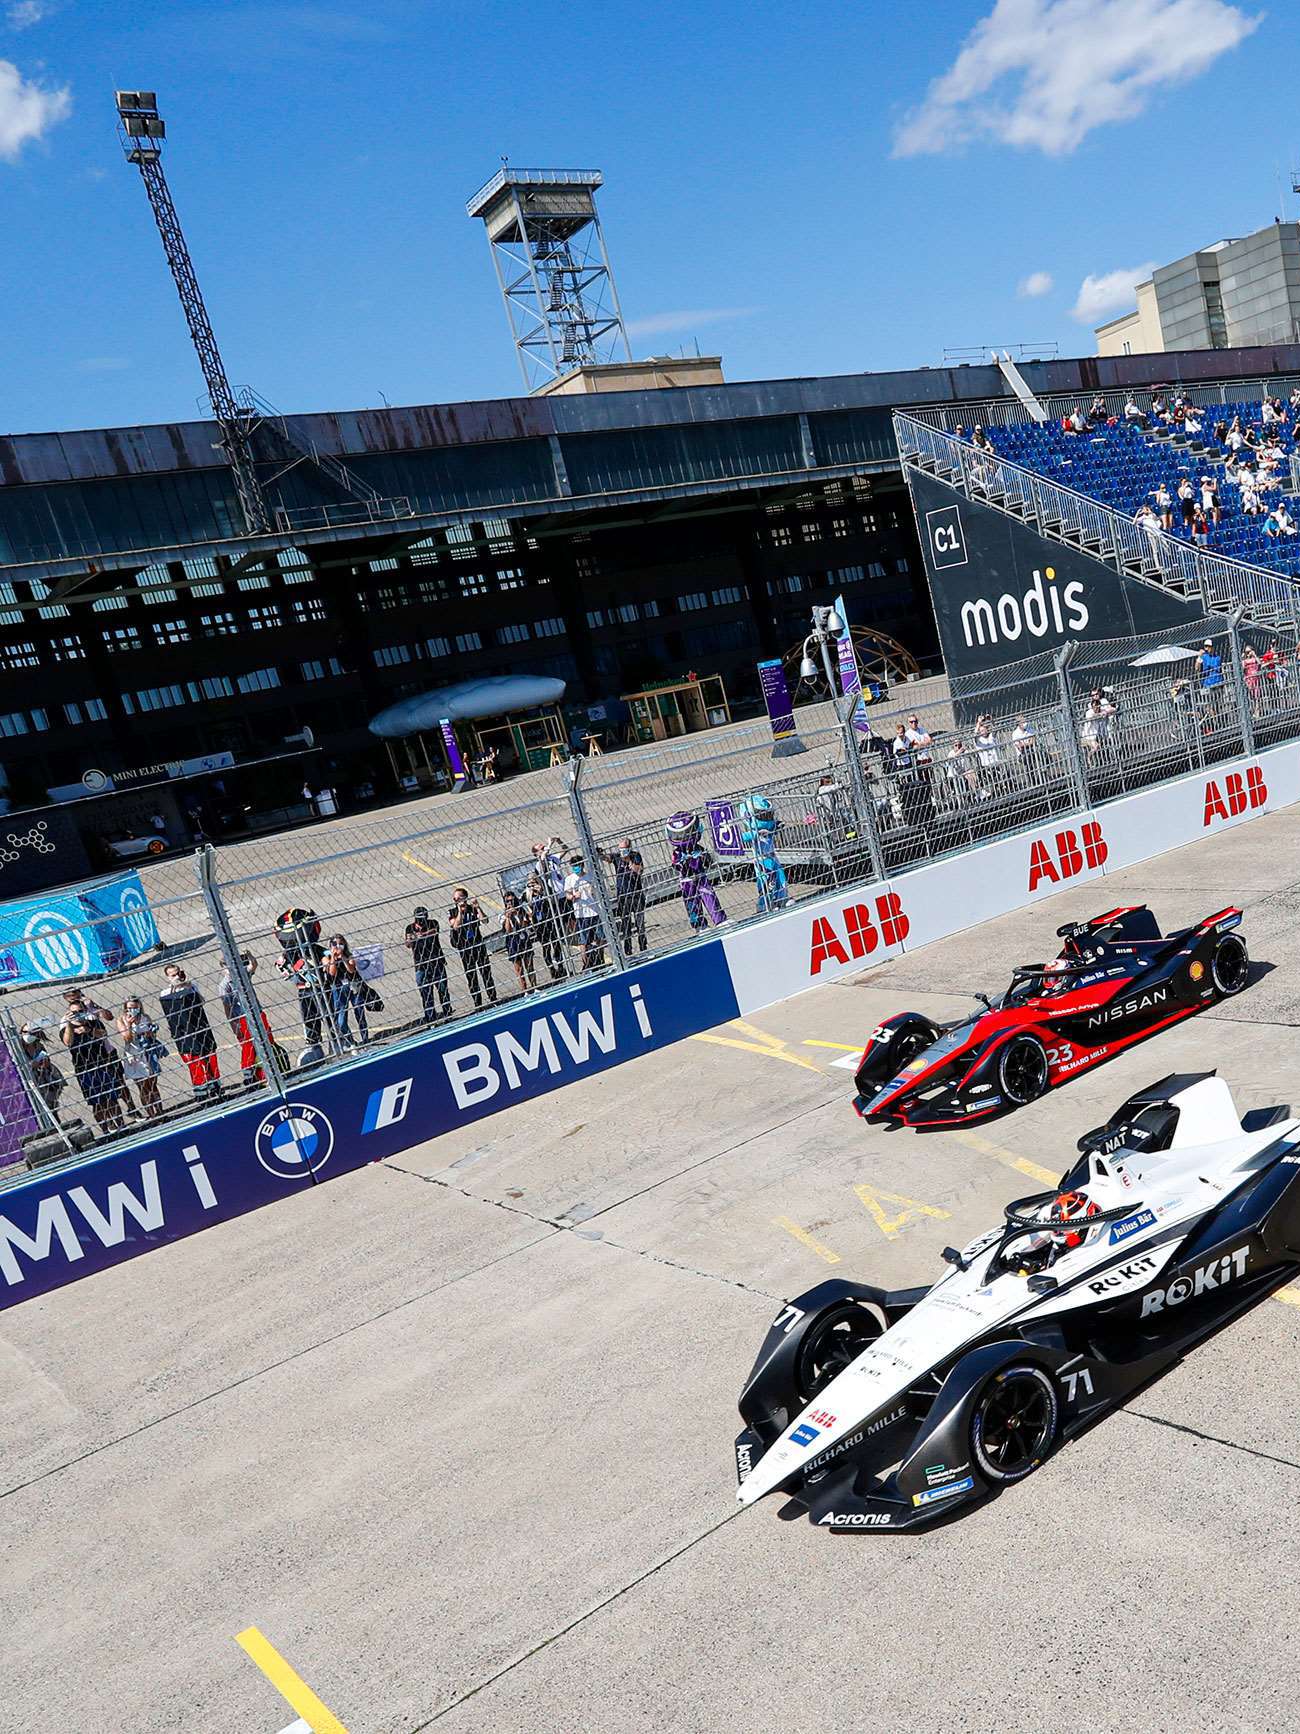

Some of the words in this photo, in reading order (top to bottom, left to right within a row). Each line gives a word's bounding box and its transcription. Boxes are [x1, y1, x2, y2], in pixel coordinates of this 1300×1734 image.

[934, 525, 960, 553] C1
[961, 566, 1089, 647] modis
[112, 769, 138, 782] MINI
[1203, 766, 1267, 827] ABB
[1028, 821, 1108, 892] ABB
[810, 892, 910, 976] ABB
[1073, 924, 1089, 937] BUE
[1088, 988, 1167, 1029] NISSAN
[442, 993, 617, 1110] BMW
[629, 983, 653, 1039] i
[870, 1026, 895, 1044] 23
[1046, 1043, 1073, 1066] 23
[1058, 1055, 1090, 1073] RICHARD
[1090, 1046, 1108, 1061] MILLE
[1104, 1131, 1126, 1153] NAT
[182, 1144, 218, 1210] i
[1113, 1219, 1138, 1239] Julius
[1137, 1211, 1153, 1228] Bär
[772, 1305, 806, 1333] 71
[1060, 1368, 1094, 1401] 71
[806, 1409, 840, 1428] ABB
[803, 1432, 864, 1474] RICHARD
[868, 1406, 907, 1436] MILLE
[818, 1511, 891, 1525] Acronis
